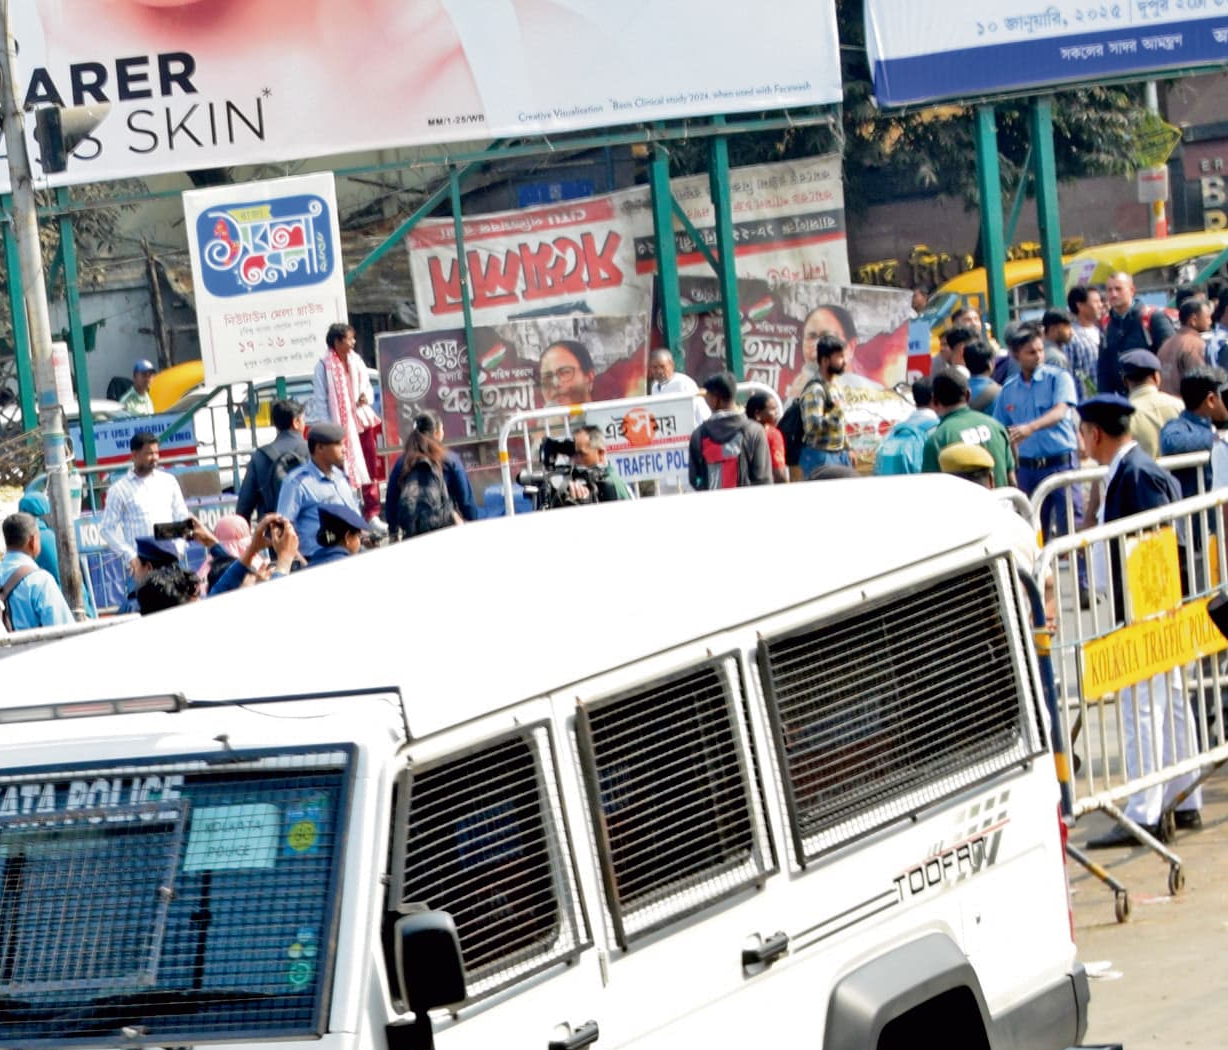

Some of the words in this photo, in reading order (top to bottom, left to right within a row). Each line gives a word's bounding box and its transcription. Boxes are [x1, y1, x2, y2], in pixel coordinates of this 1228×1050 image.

[634, 96, 664, 108] Clinical
[666, 94, 687, 106] study
[518, 111, 551, 123] Creative
[111, 427, 130, 438] USE
[616, 452, 664, 477] TRAFFIC
[667, 450, 689, 473] POL
[1089, 638, 1141, 687] KOLKATA
[1144, 617, 1184, 665] TRAFFIC
[64, 775, 184, 826] POLICE
